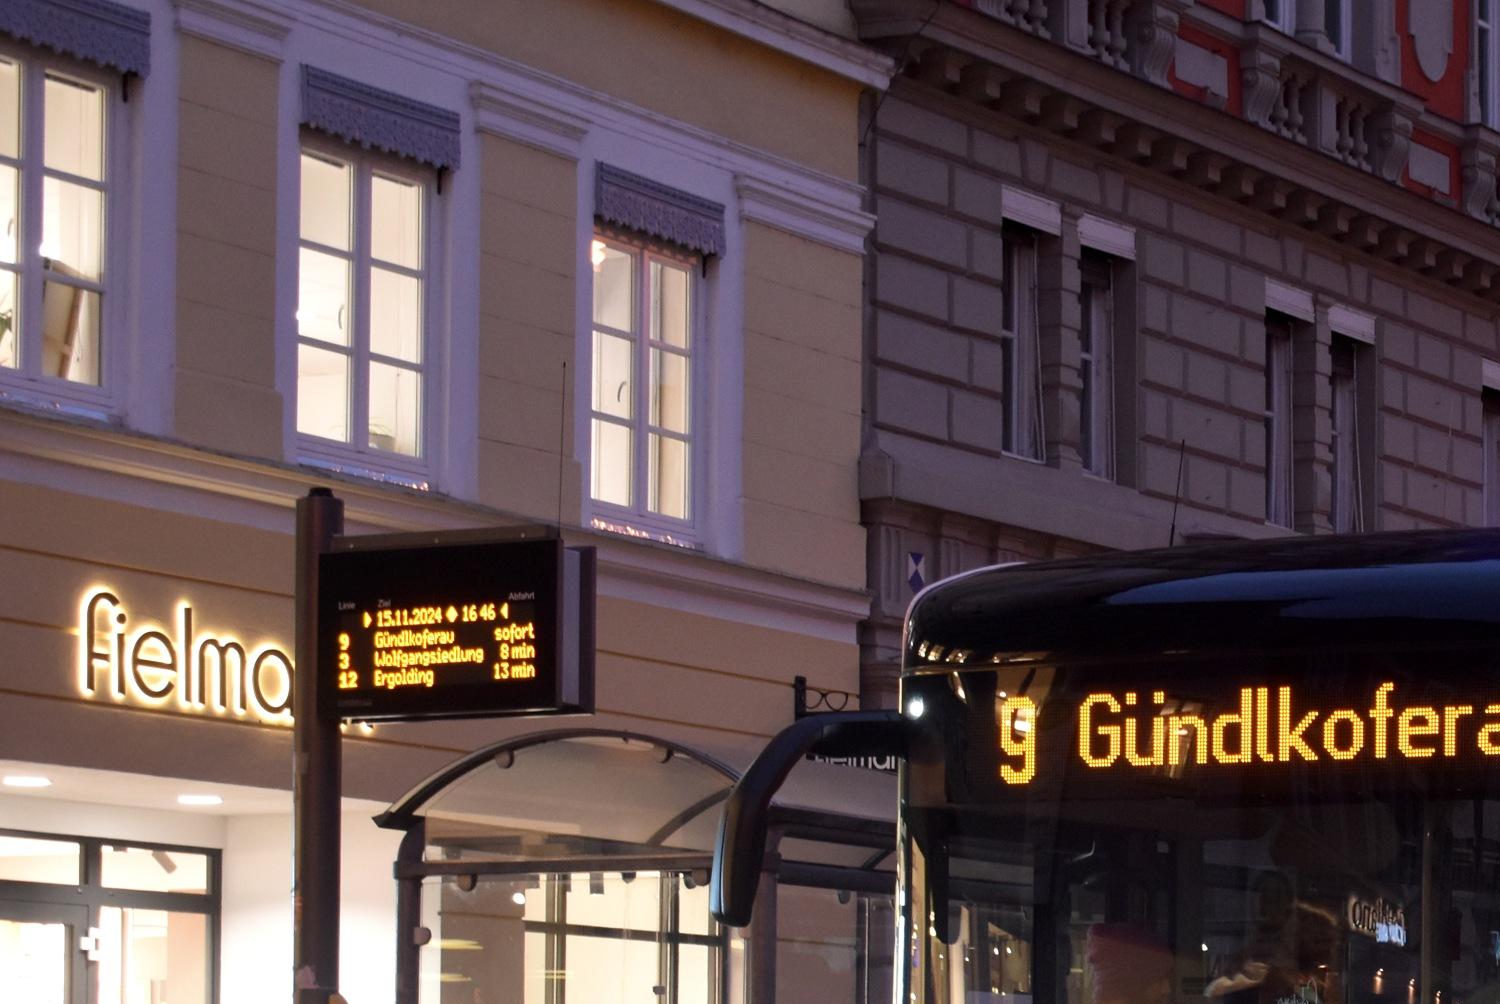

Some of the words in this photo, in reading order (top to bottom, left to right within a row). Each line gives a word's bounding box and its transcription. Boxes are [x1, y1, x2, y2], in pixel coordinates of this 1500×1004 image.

[508, 591, 535, 601] Abfahrt
[377, 607, 442, 628] 15.11.2024
[338, 633, 349, 650] 9
[374, 628, 455, 649] Gündlkoferau
[494, 622, 535, 643] sofort
[86, 591, 296, 717] fielma
[339, 653, 350, 669] 3
[374, 646, 484, 668] Wolfgangsiedlung
[500, 643, 509, 660] 8
[511, 642, 535, 659] min
[338, 671, 358, 689] 12
[374, 669, 434, 689] Ergolding
[494, 662, 510, 680] 13
[511, 661, 535, 679] min
[1000, 695, 1037, 785] 9
